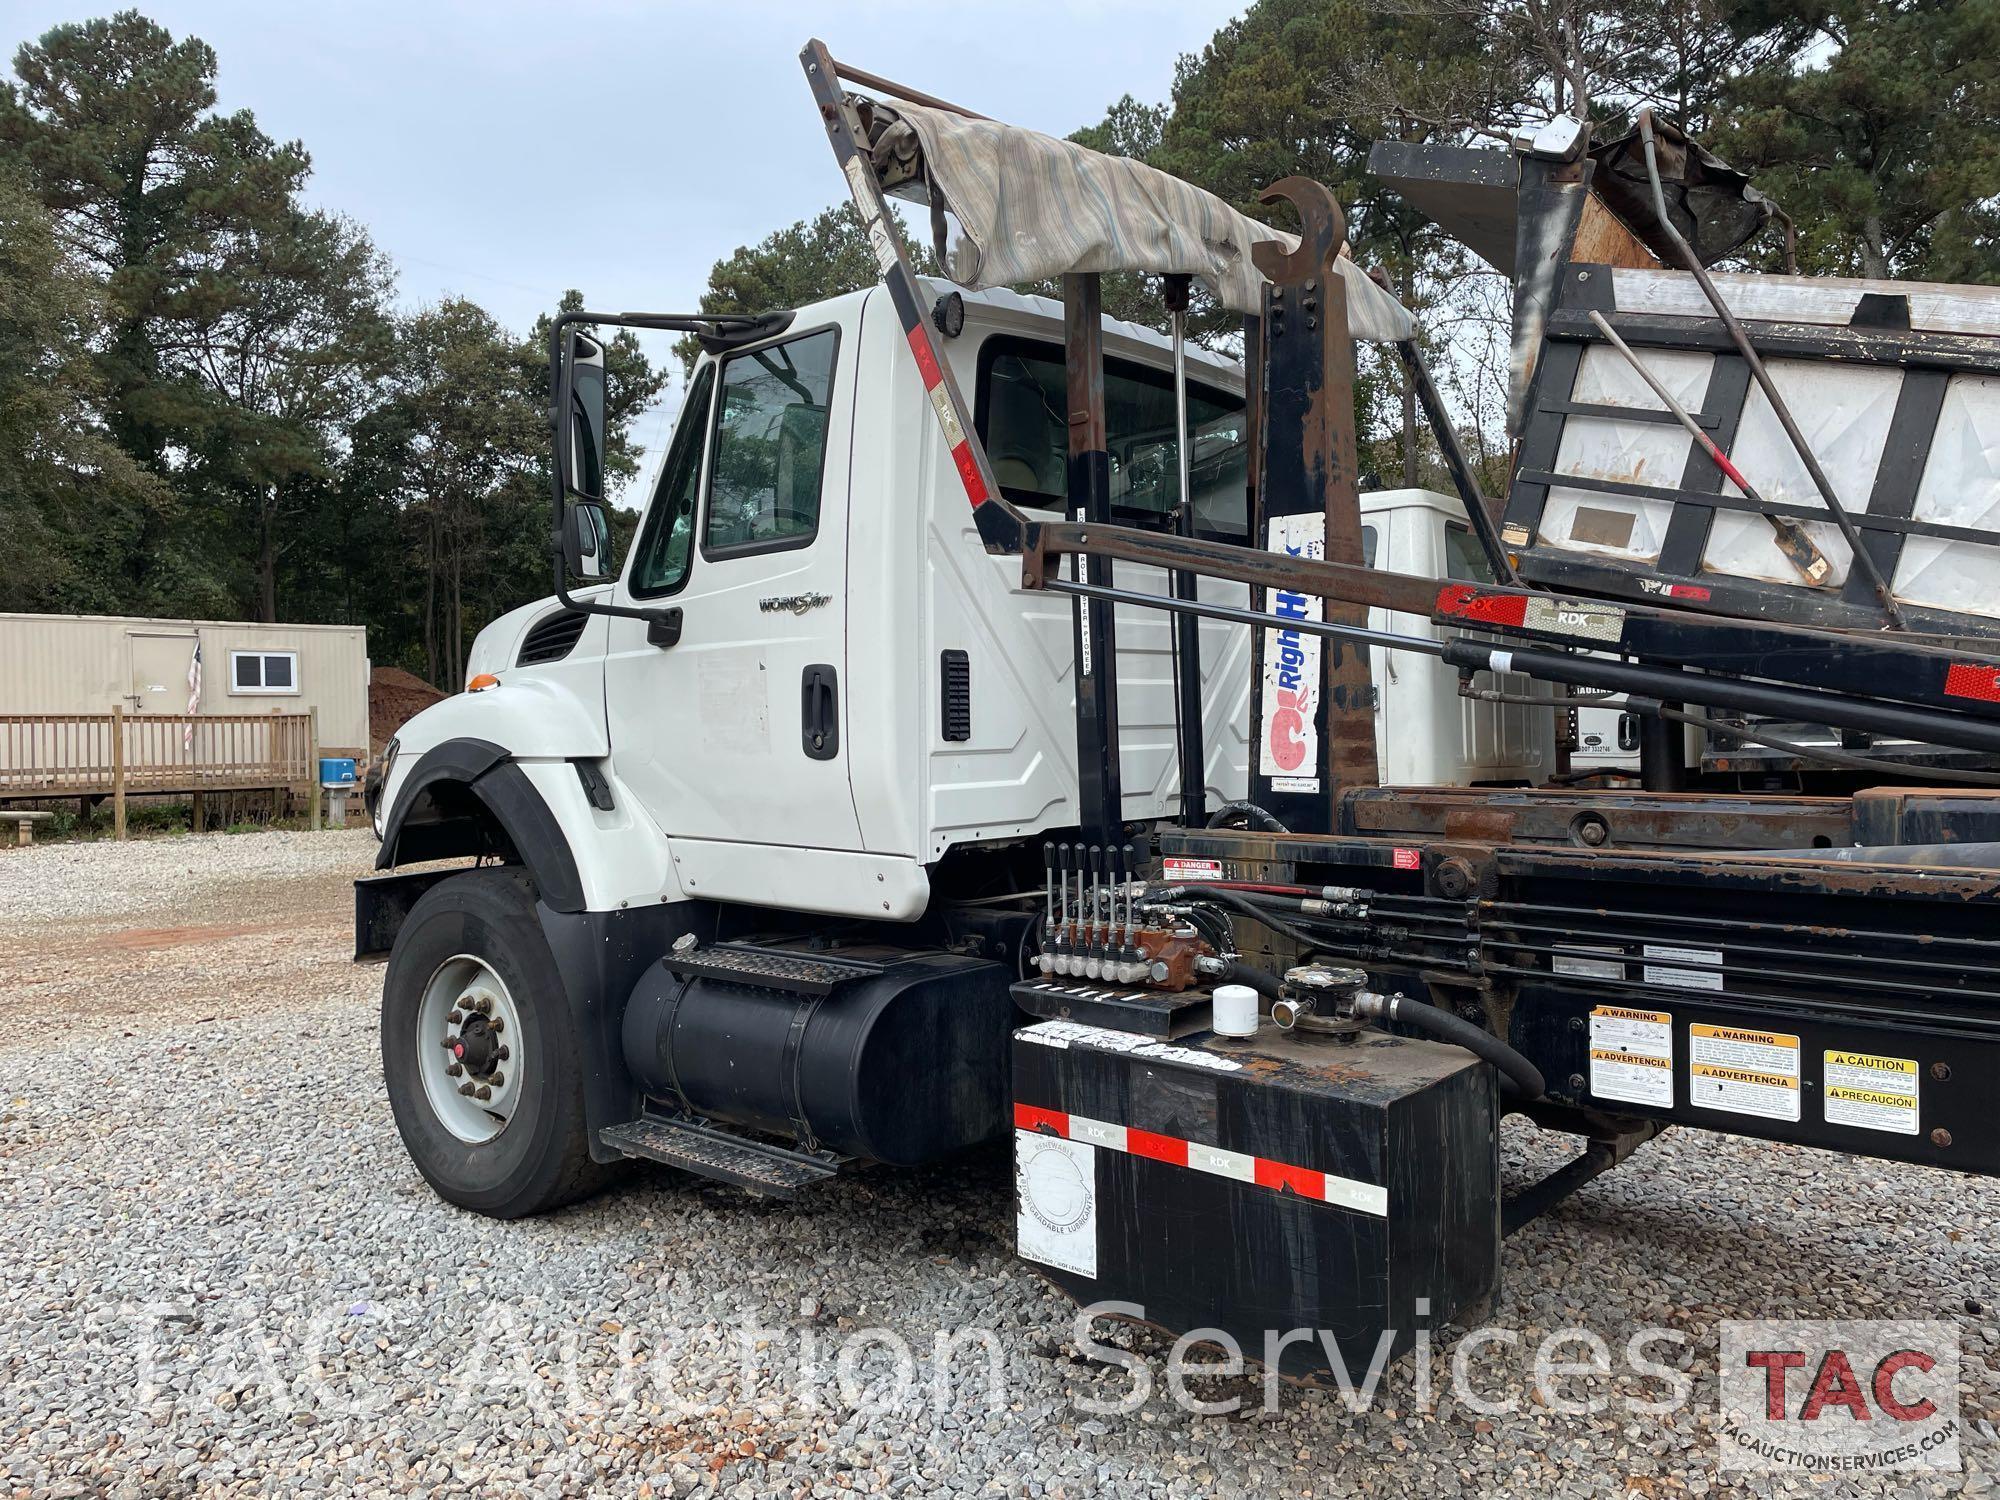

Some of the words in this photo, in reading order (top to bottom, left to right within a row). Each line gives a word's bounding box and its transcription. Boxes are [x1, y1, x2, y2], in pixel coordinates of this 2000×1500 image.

[1181, 861, 1211, 870] DANGER
[1610, 1009, 1658, 1021] WARNING
[1722, 1030, 1774, 1044] WARNING
[1604, 1053, 1666, 1068] ADVERTENCIA
[1847, 1056, 1904, 1071] CAUTION
[1711, 1069, 1788, 1087] ADVERTENCIA
[1842, 1090, 1912, 1107] PRECAUCIÓN
[1087, 1126, 1106, 1139] RDK
[1035, 1142, 1074, 1158] RENEWABLE
[1209, 1155, 1231, 1169] RDK
[1068, 1192, 1093, 1233] LUBRICANTS
